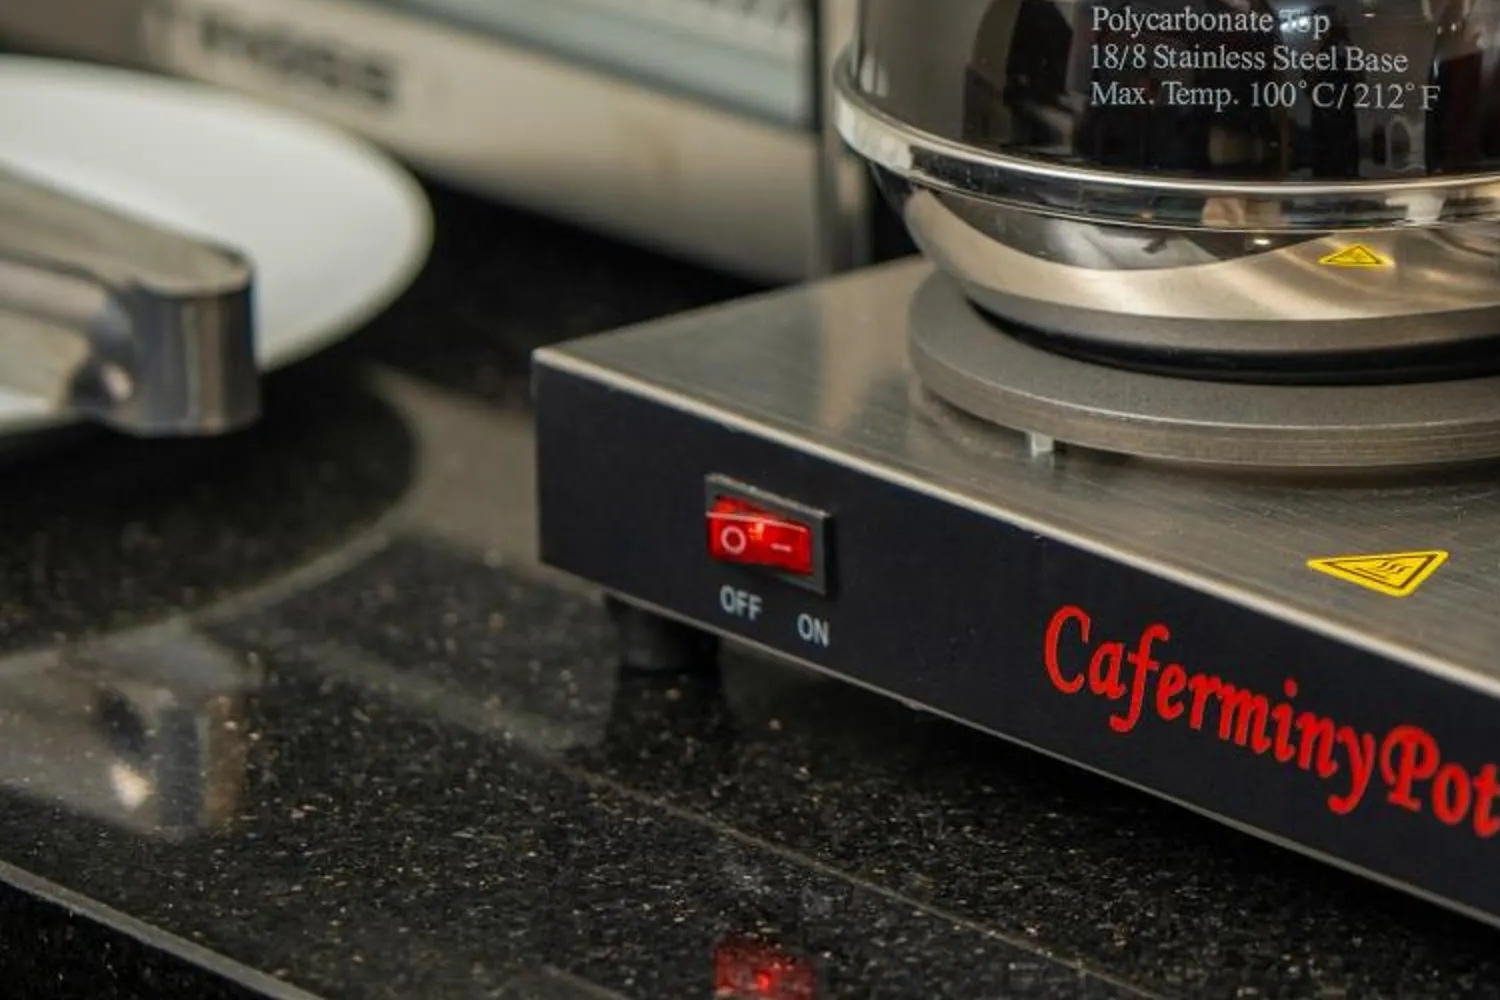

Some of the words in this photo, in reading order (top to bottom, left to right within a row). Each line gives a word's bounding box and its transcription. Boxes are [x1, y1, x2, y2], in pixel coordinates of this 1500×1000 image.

[1091, 5, 1274, 39] Polycarbonate
[1091, 43, 1148, 71] 18/8
[1153, 43, 1266, 70] Stainless
[1272, 44, 1338, 72] Steel
[1344, 47, 1409, 73] Base
[1090, 81, 1155, 107] Max.
[1161, 81, 1239, 113] Temp.
[719, 584, 763, 621] OFF
[797, 612, 831, 648] ON
